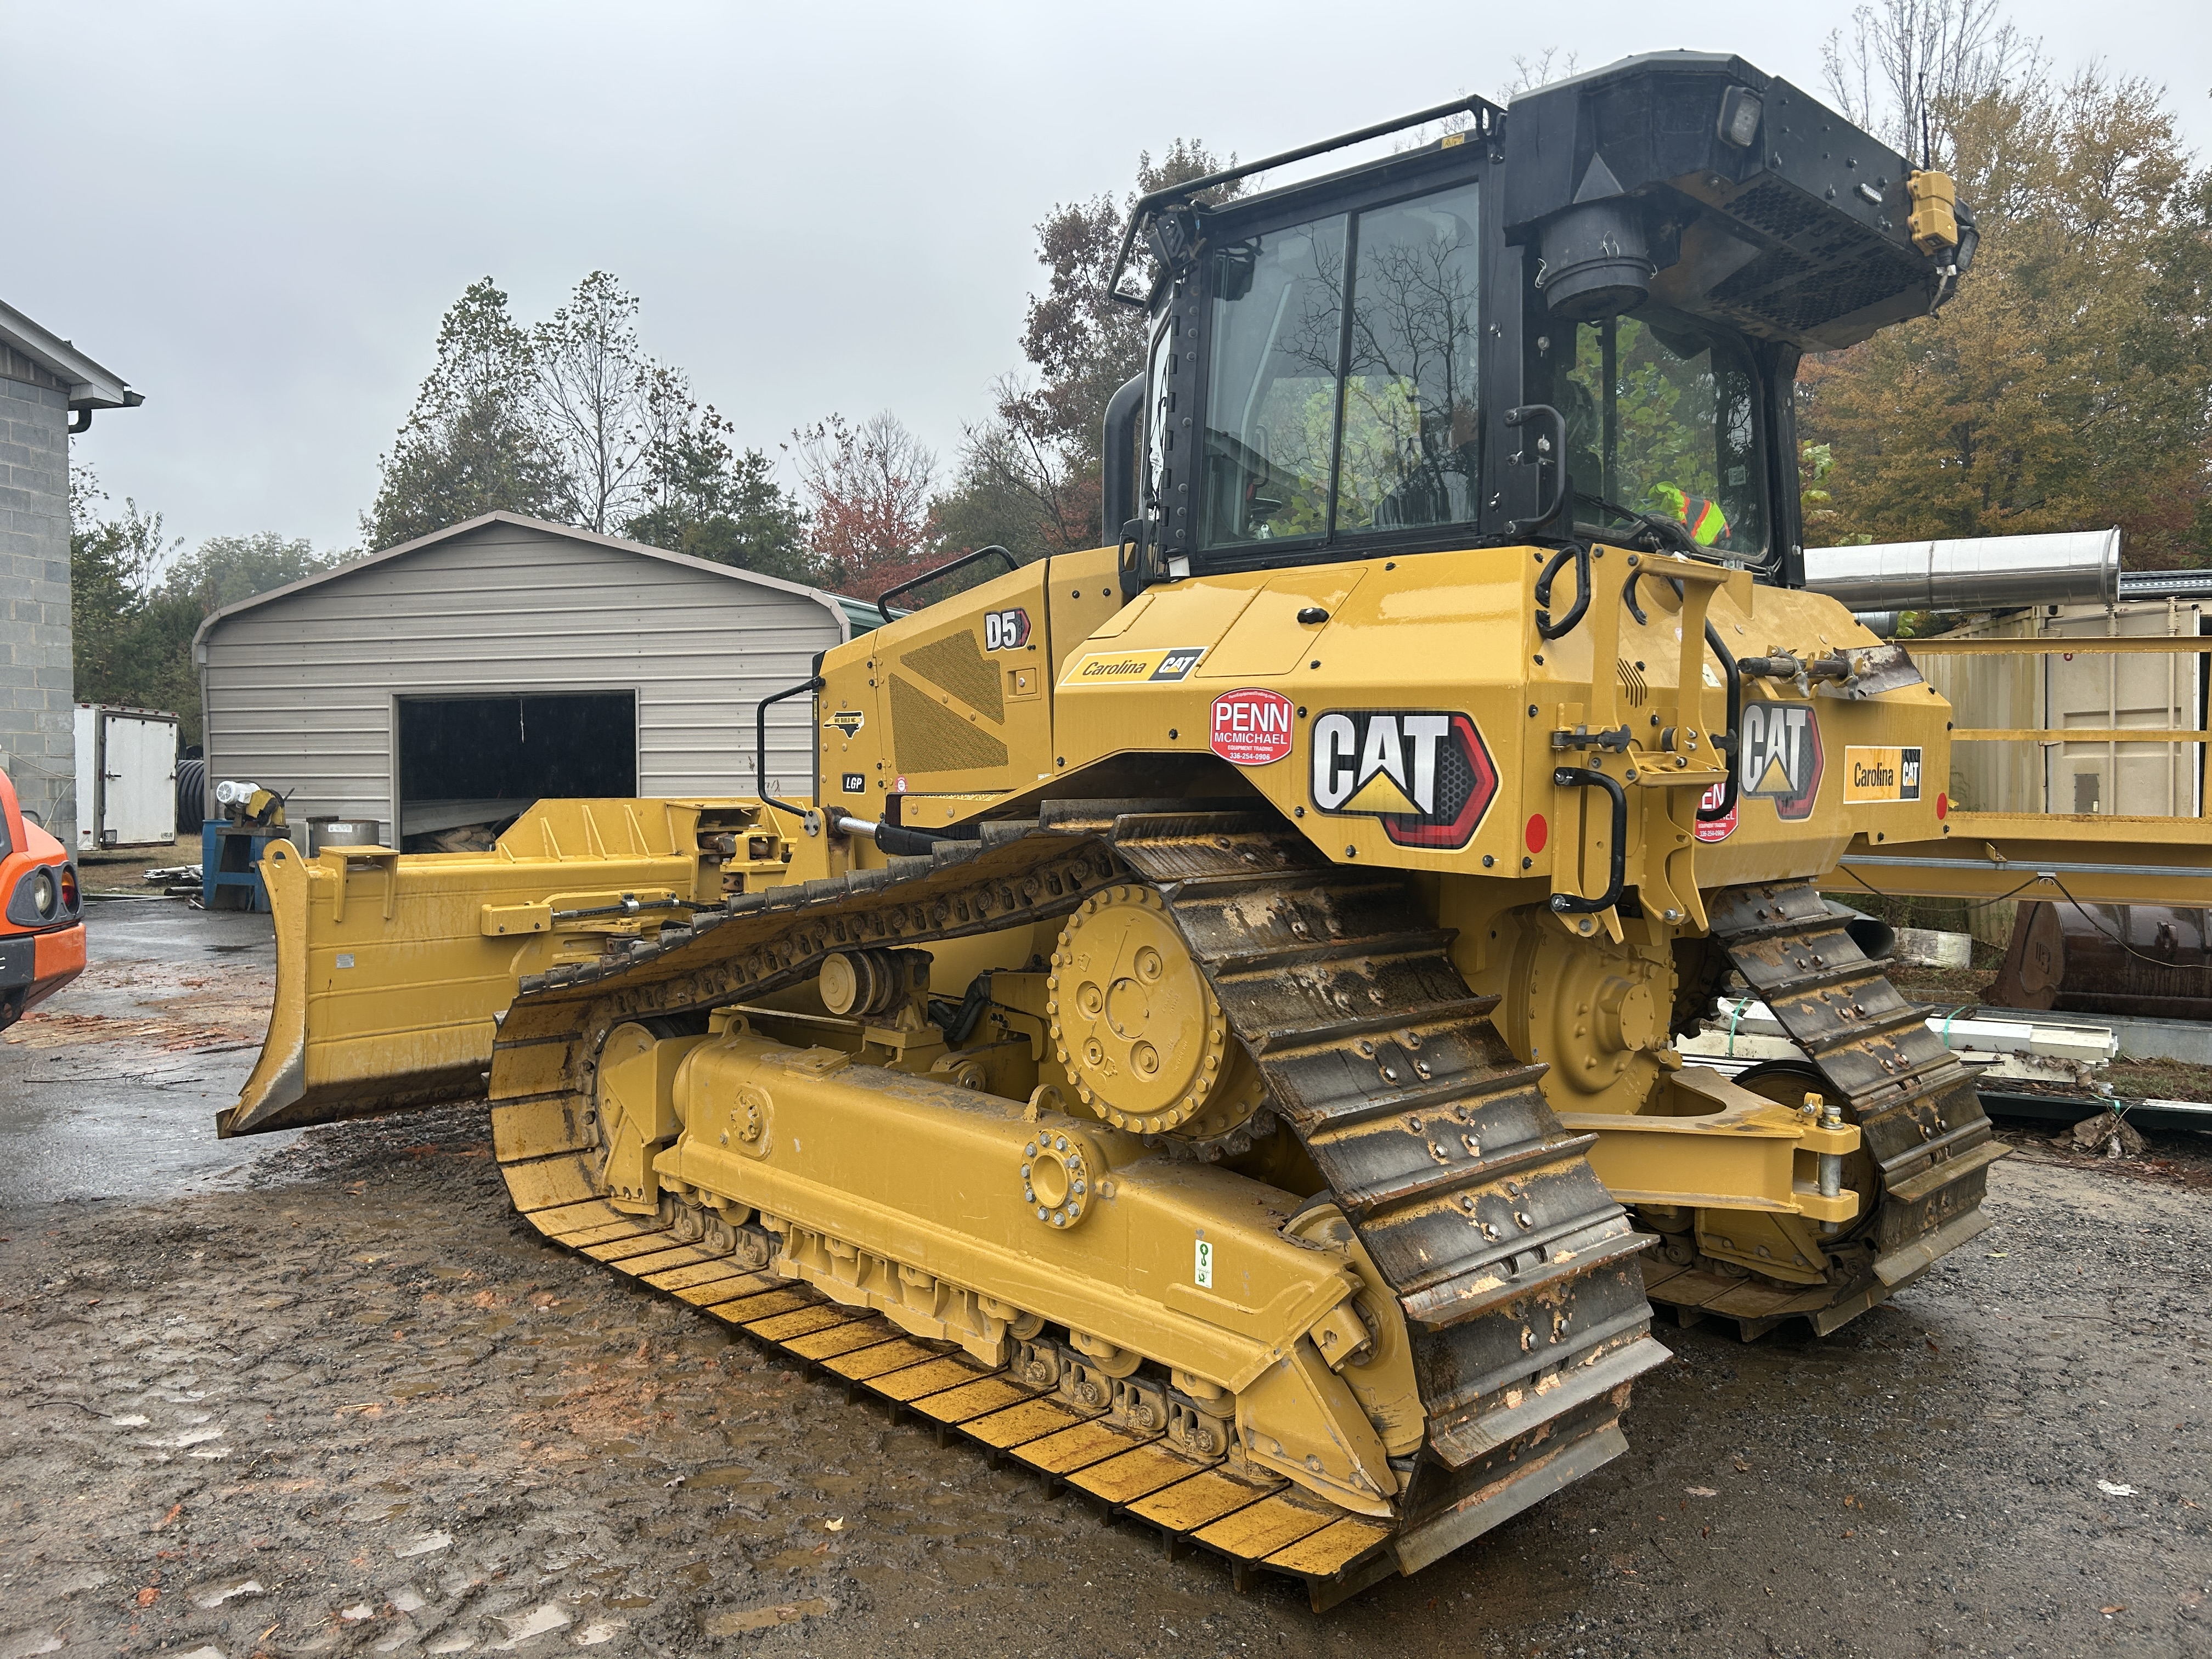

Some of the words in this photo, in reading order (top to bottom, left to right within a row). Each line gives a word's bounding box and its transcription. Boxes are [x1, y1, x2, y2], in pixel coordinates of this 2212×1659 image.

[986, 611, 1016, 648] D5
[1082, 659, 1147, 676] Carolina
[1158, 656, 1196, 674] CAT
[1215, 702, 1288, 732] PENN
[1214, 732, 1288, 744] MCMICHAEL
[1741, 704, 1806, 792] CAT
[1229, 752, 1271, 760] 336-254-0906
[1313, 714, 1449, 815] CAT
[846, 777, 862, 789] LGP
[1854, 762, 1894, 787] Carolina
[1902, 761, 1919, 787] CAT
